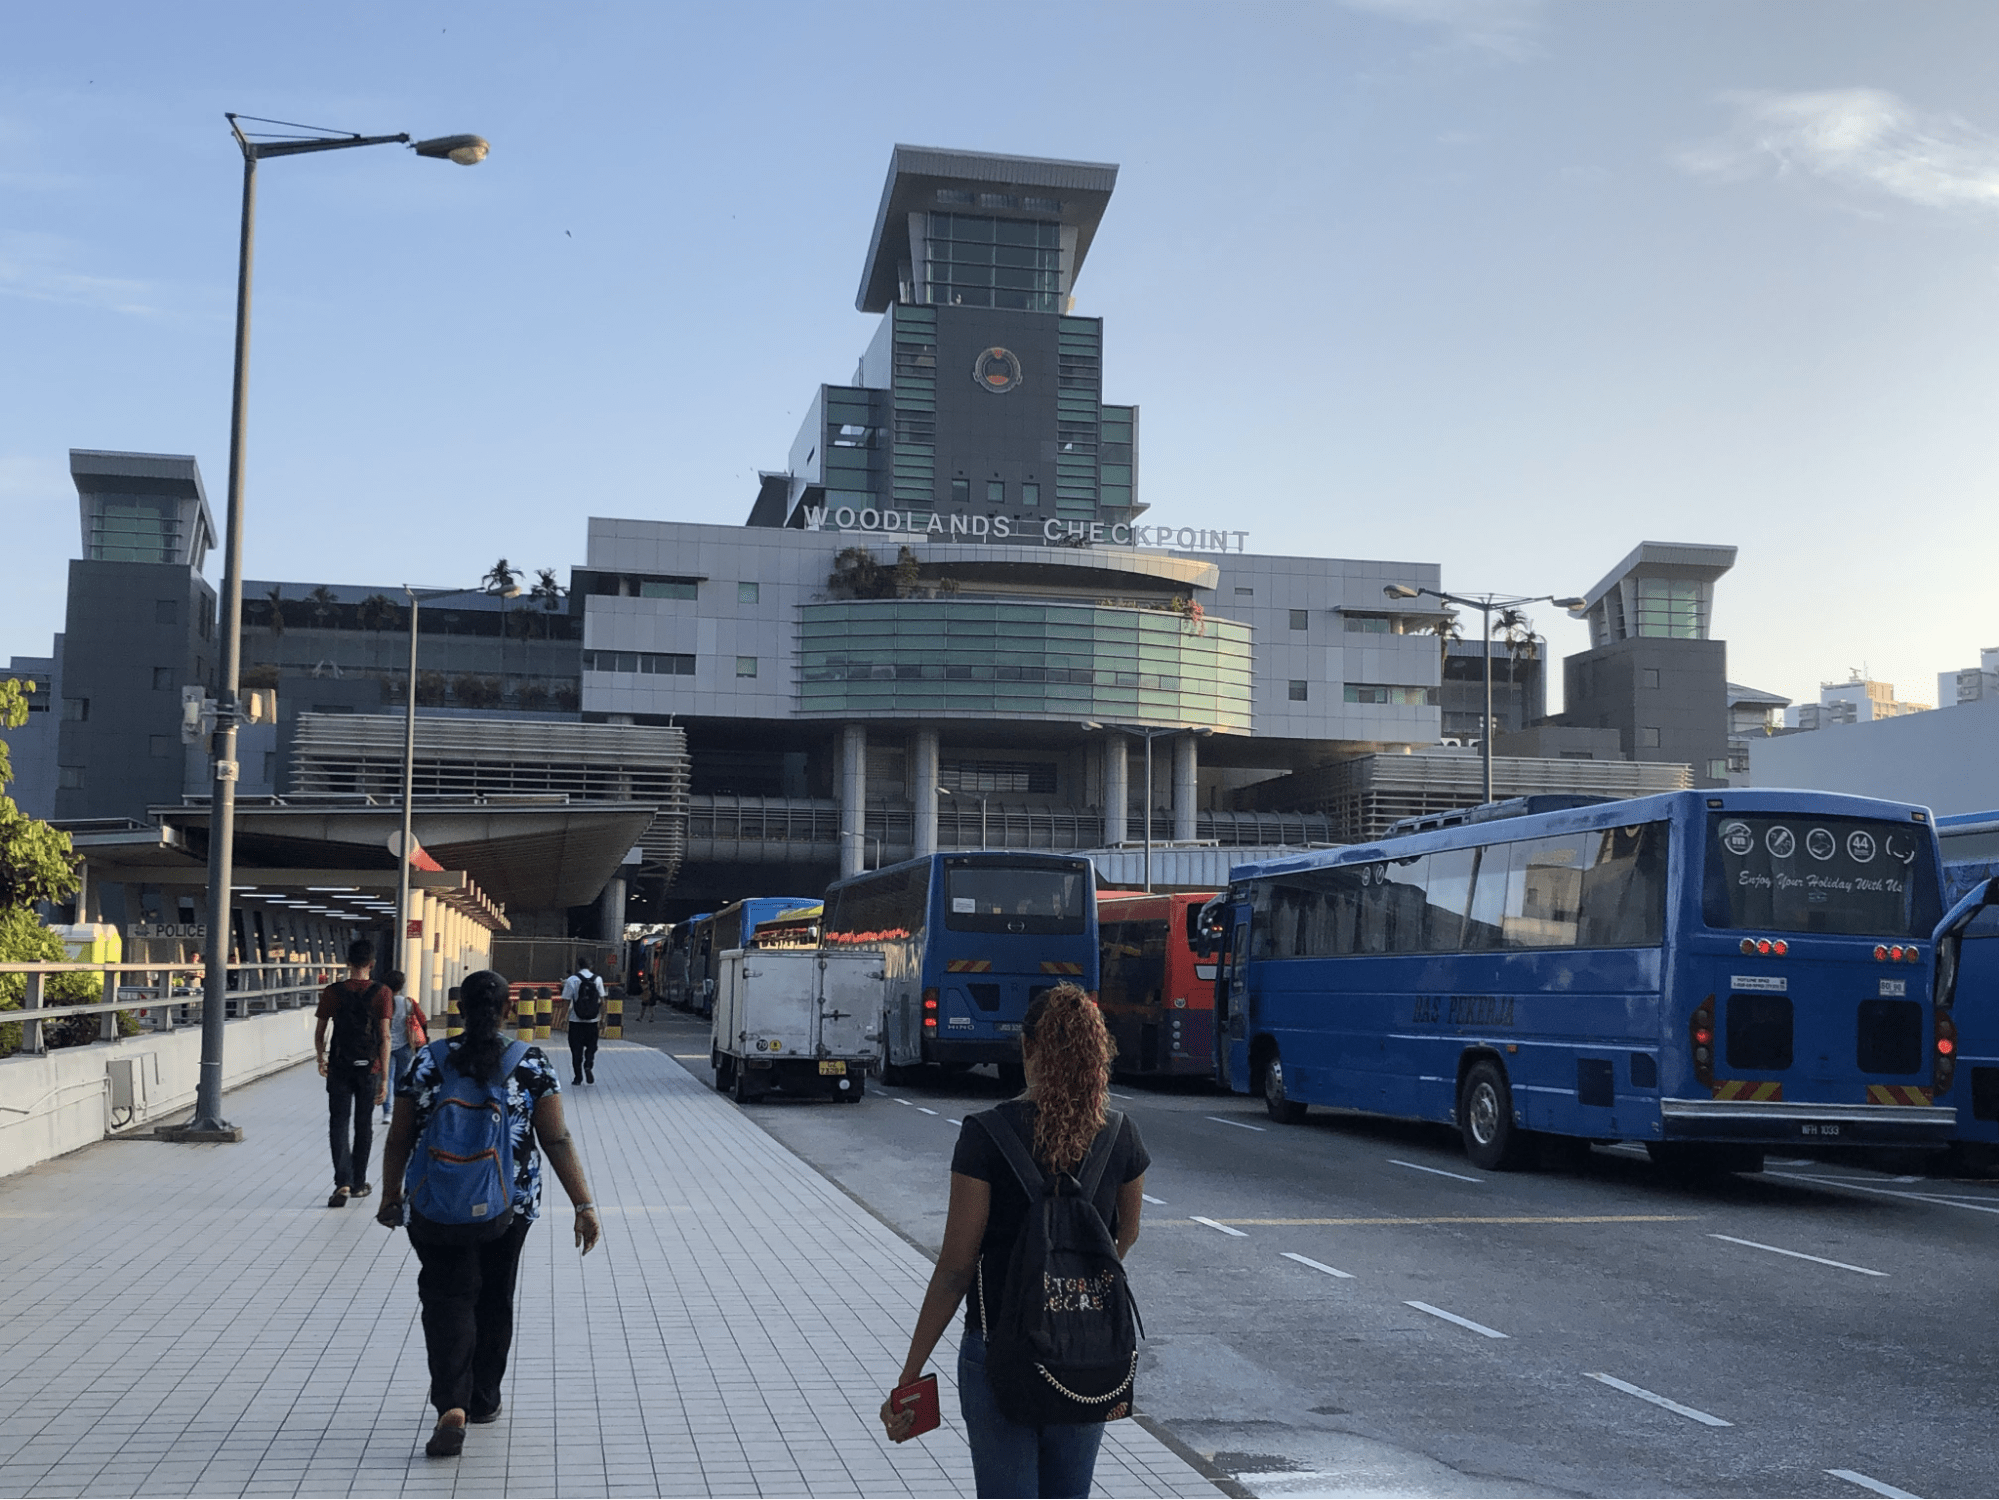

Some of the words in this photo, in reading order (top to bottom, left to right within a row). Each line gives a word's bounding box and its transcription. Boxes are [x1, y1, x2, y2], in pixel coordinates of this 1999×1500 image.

[803, 504, 1010, 538] WOODLANDS
[1043, 518, 1250, 551] CHECKPOINT
[1852, 836, 1869, 849] 44
[1738, 870, 1772, 888] Enjoy
[1776, 872, 1804, 890] Your
[1806, 874, 1853, 893] Holiday
[1855, 877, 1883, 892] With
[1885, 878, 1903, 893] Us
[156, 924, 206, 938] POLICE
